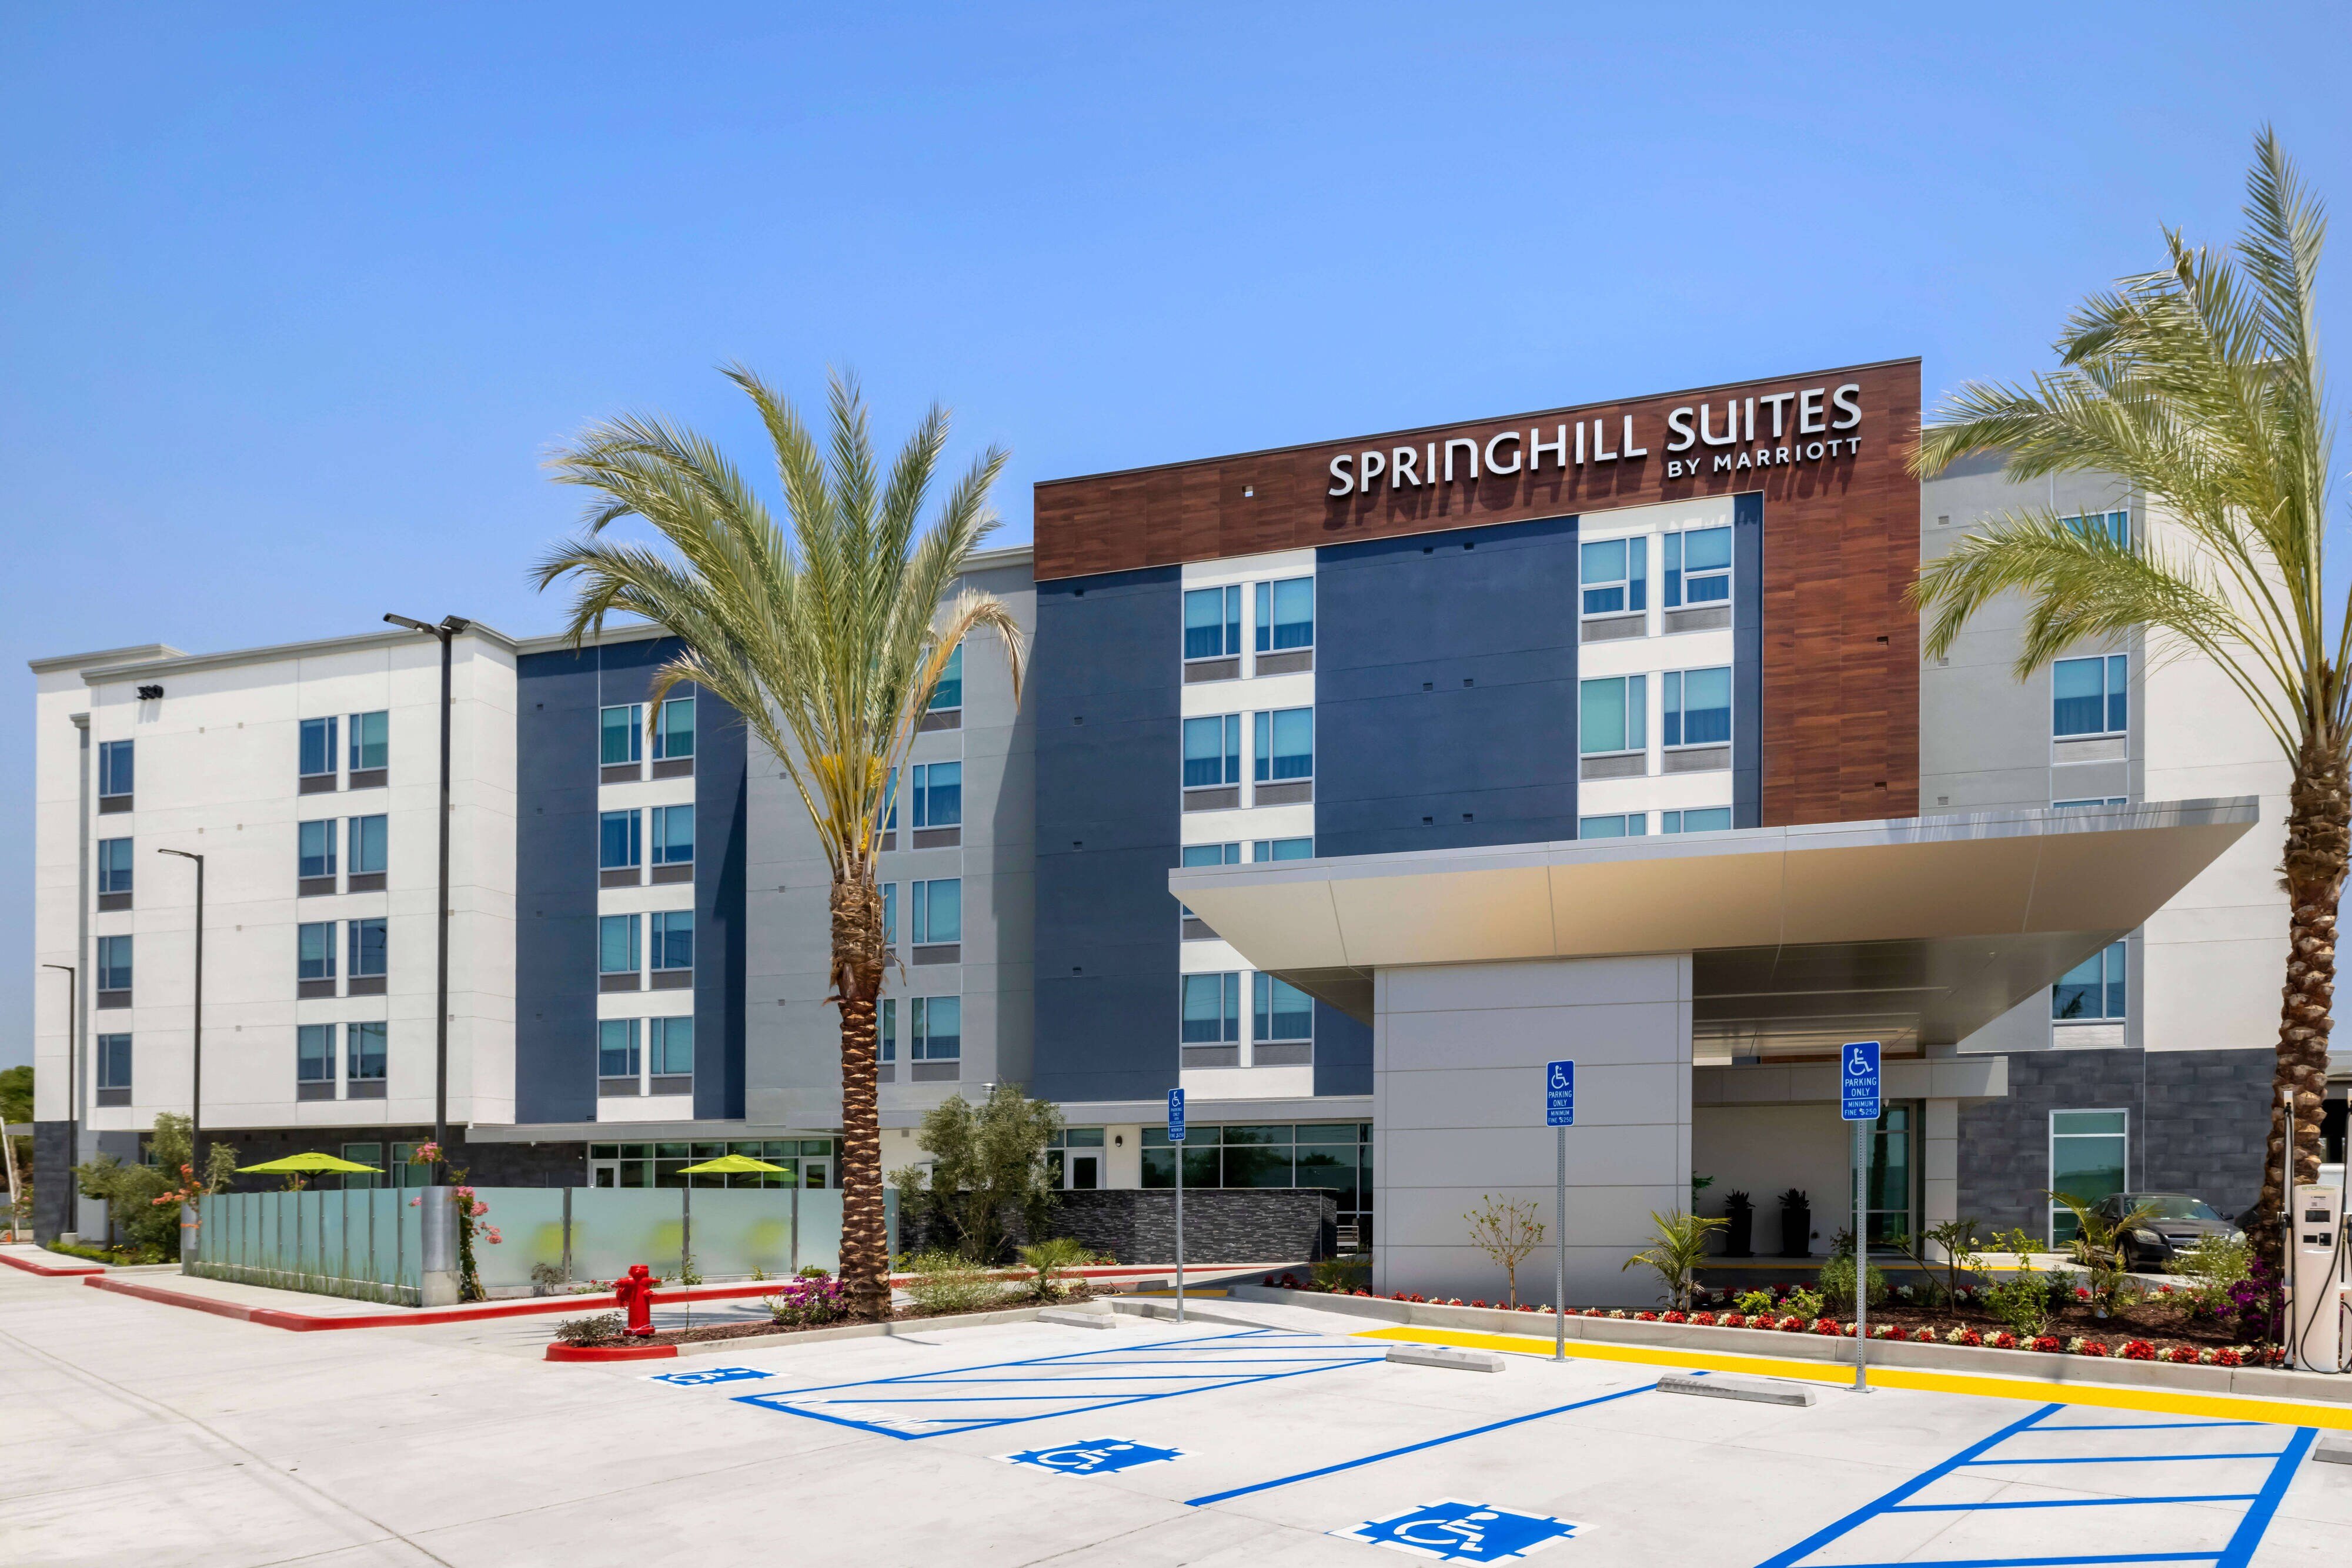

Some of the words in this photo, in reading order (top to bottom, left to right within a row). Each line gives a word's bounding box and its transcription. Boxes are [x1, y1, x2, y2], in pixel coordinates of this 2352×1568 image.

[1328, 414, 1647, 496] SPRINGHILL
[1666, 384, 1862, 452] SUITES
[1668, 457, 1700, 478] BY
[1713, 437, 1862, 472] MARRIOTT
[1845, 1077, 1877, 1086] PARKING
[1548, 1090, 1572, 1098] PARKING
[1851, 1088, 1870, 1096] ONLY
